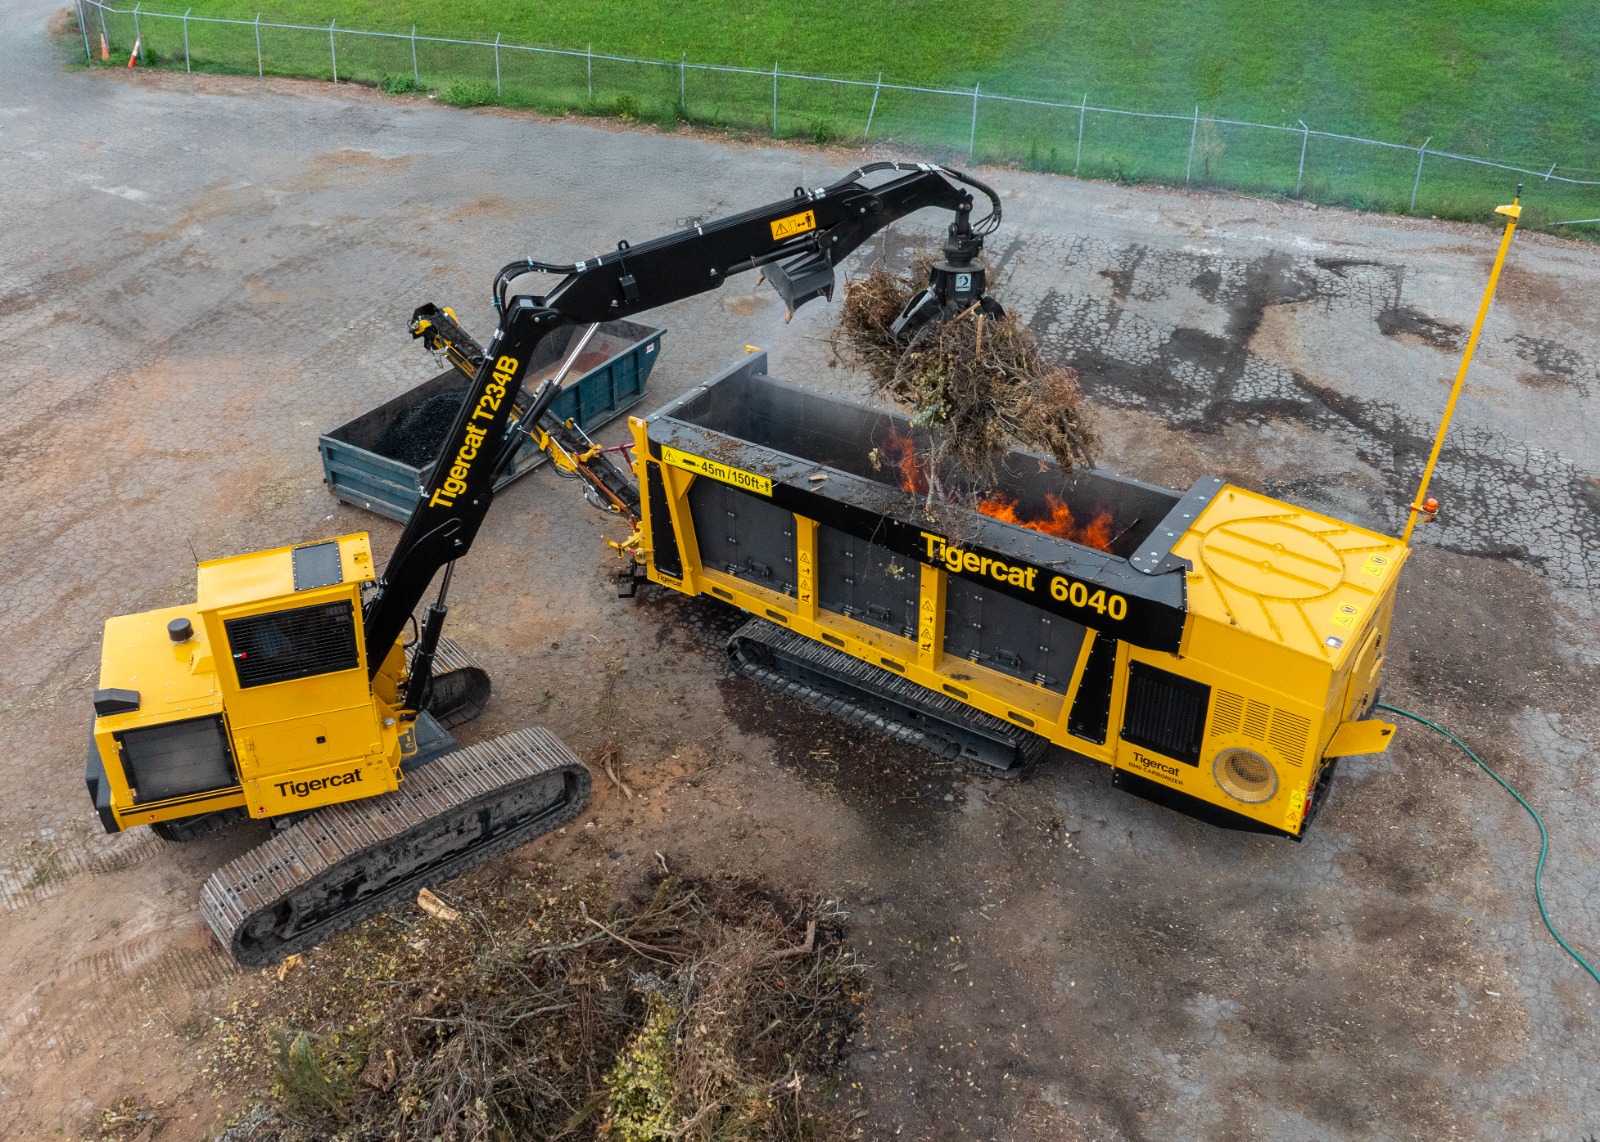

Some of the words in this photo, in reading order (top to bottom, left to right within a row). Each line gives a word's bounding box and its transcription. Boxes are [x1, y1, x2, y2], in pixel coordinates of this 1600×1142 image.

[429, 422, 488, 509] Tigercat
[471, 355, 519, 420] T234B
[656, 572, 683, 588] Tigercat
[920, 531, 1038, 592] Tigercat
[1050, 576, 1128, 621] 6040
[1133, 751, 1180, 777] Tigercat
[1143, 767, 1184, 786] CARBONIZER
[274, 768, 363, 798] Tigercat
